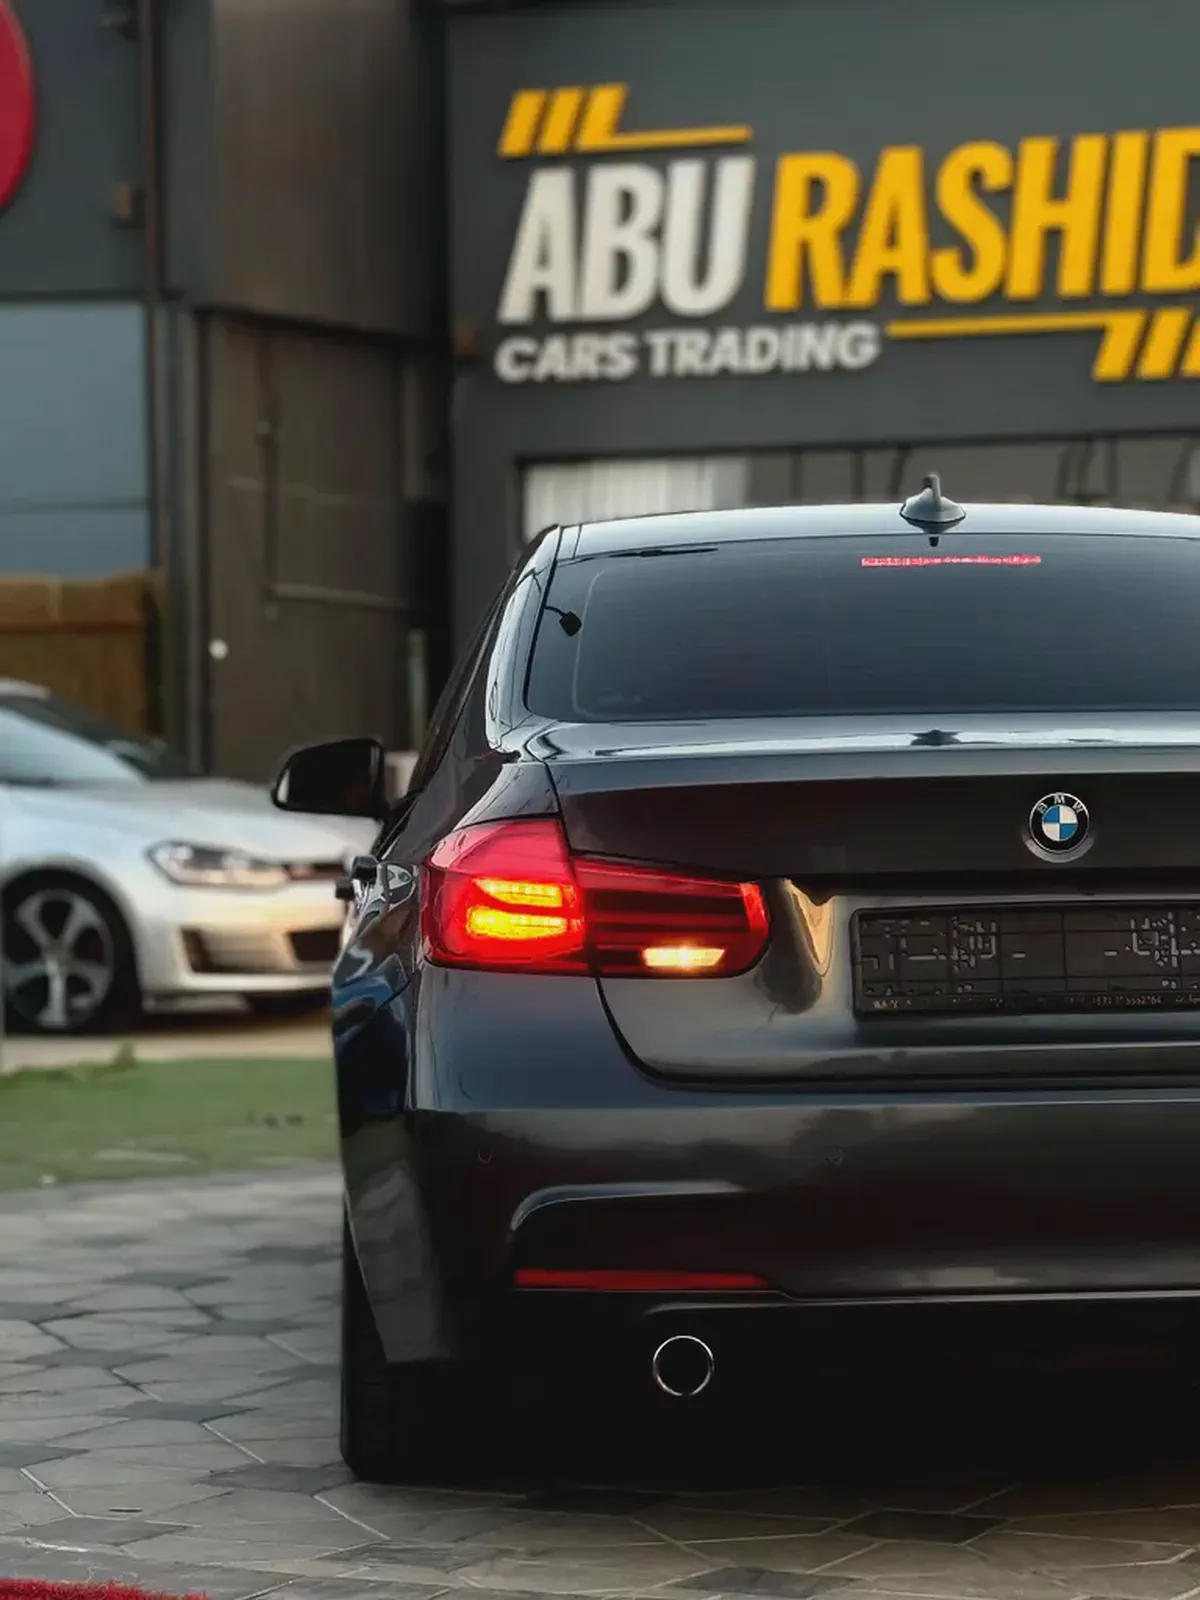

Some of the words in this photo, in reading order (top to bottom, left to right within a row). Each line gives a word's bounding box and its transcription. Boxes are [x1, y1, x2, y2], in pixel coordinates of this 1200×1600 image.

[498, 157, 756, 323] ABU
[765, 127, 1200, 312] RASHID
[495, 331, 638, 383] CARS
[645, 322, 881, 377] TRADING
[1037, 794, 1084, 814] BMW
